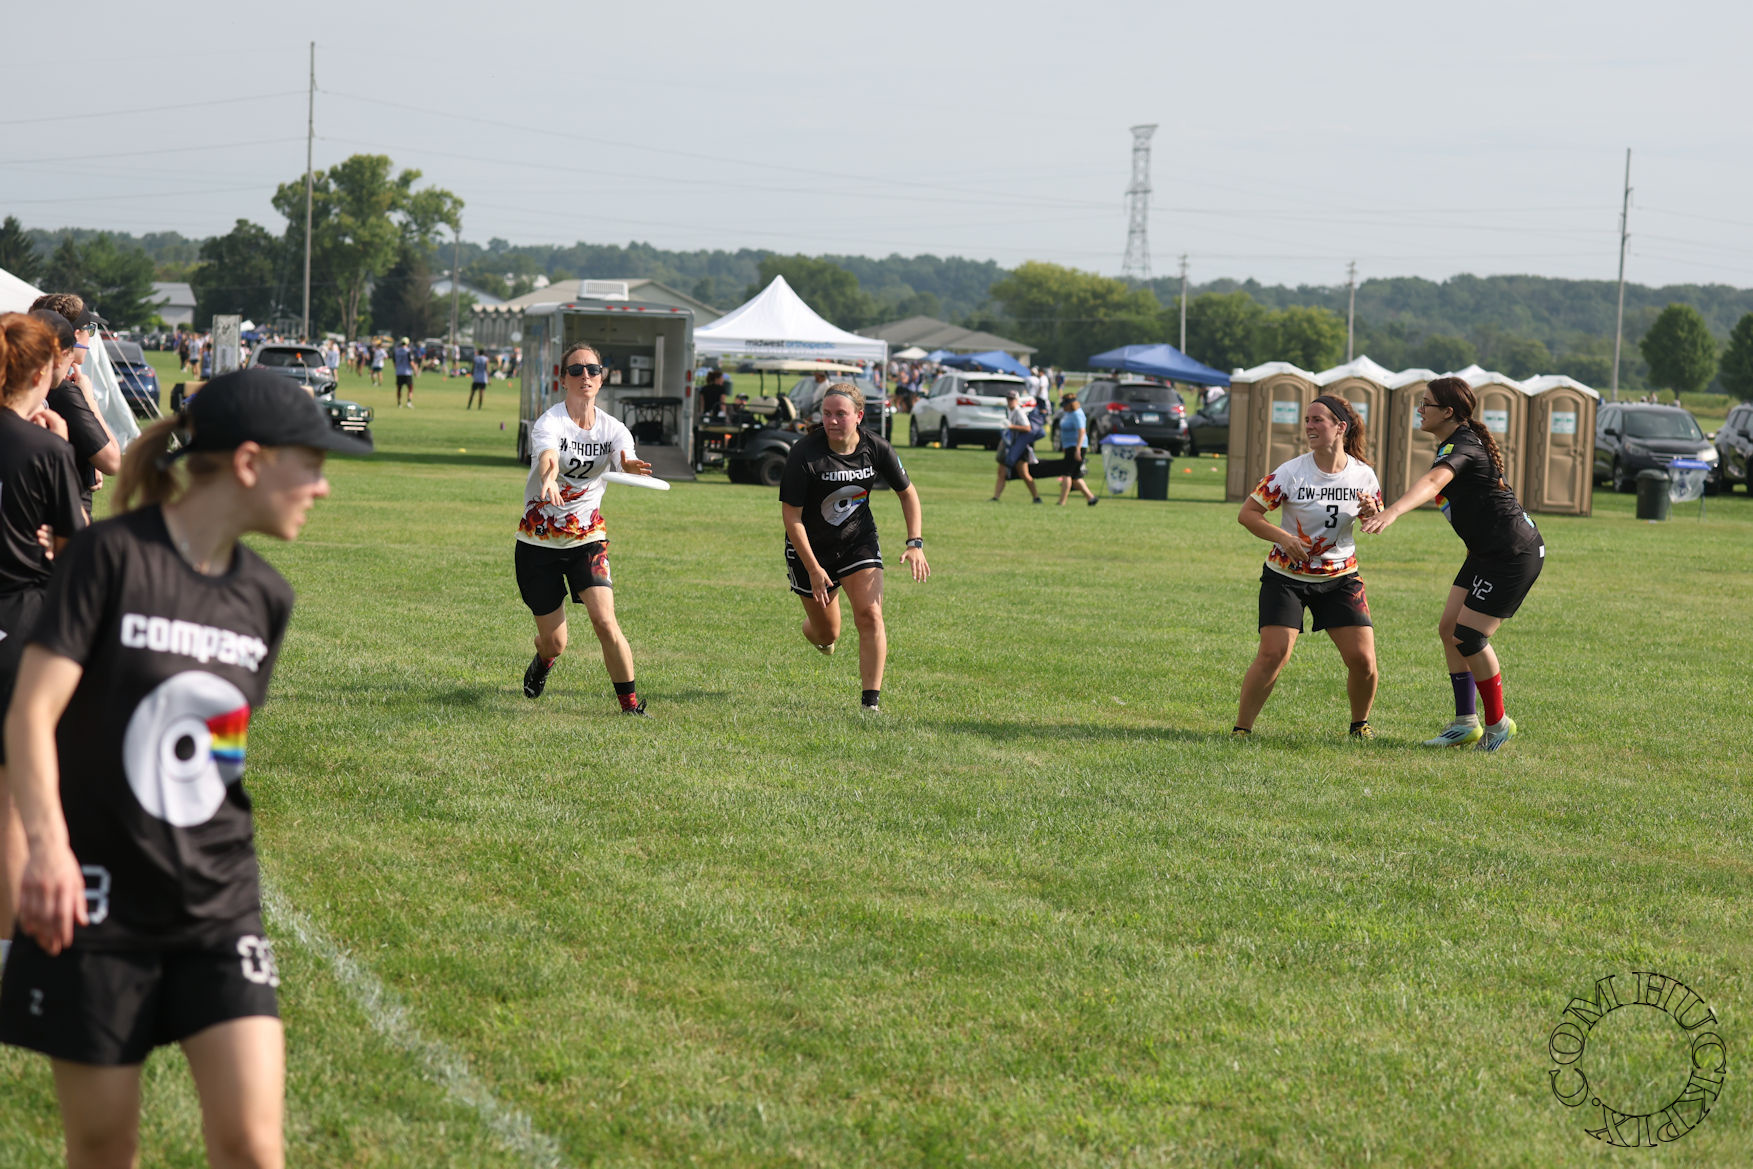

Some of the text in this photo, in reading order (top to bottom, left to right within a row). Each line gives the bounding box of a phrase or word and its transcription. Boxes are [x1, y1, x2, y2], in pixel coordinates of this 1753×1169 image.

[745, 339, 784, 347] midwest
[564, 457, 595, 479] 22
[821, 465, 875, 482] compact
[1324, 504, 1339, 529] 3
[1472, 575, 1493, 600] 42
